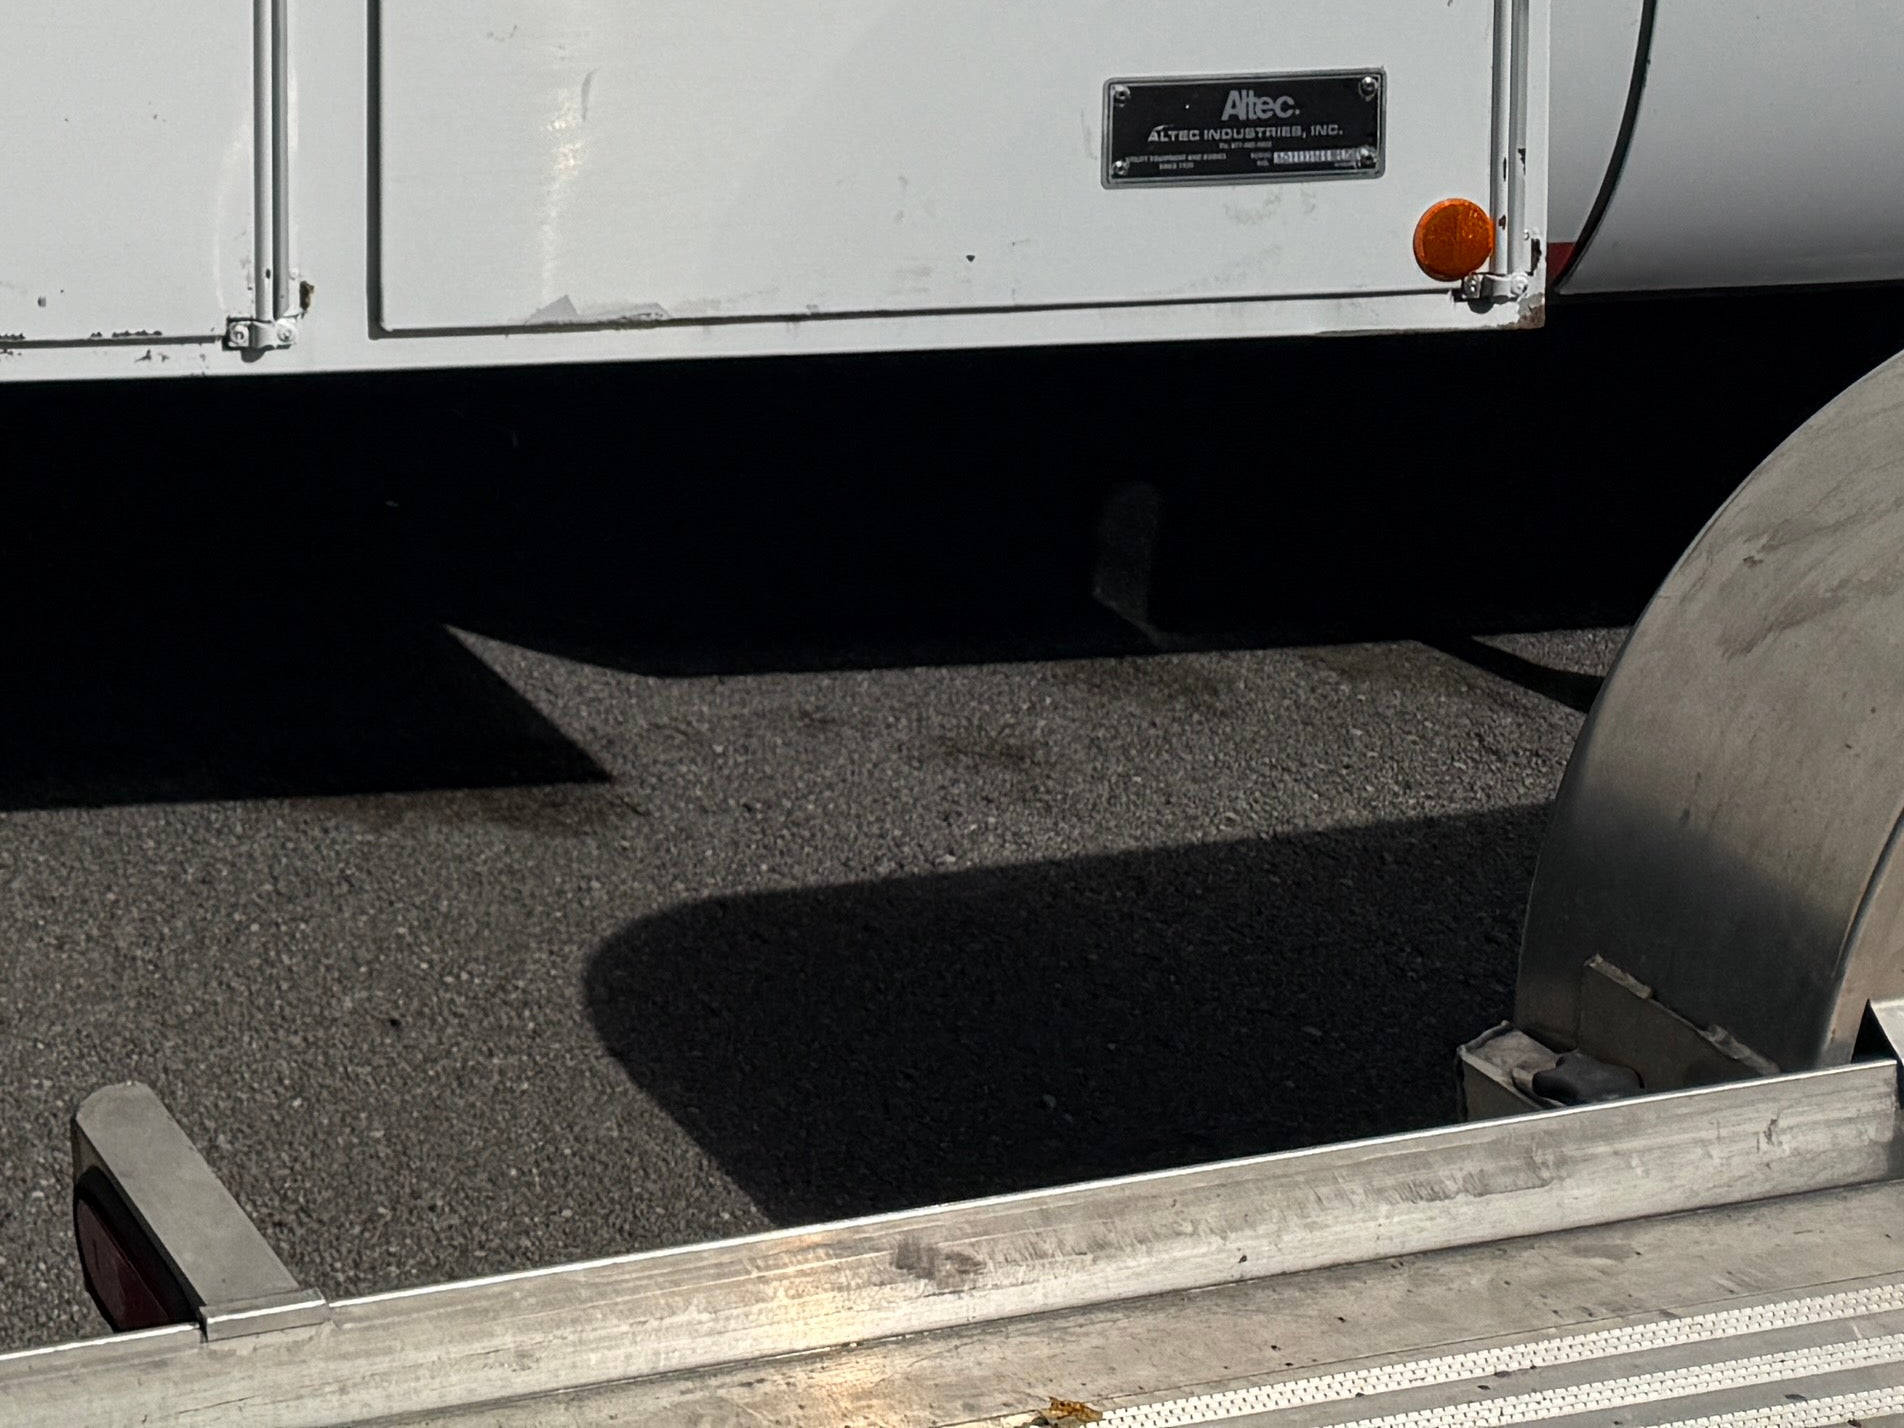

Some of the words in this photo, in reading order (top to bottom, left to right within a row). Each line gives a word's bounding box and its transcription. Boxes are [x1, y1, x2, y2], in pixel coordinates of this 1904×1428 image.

[1221, 89, 1299, 121] Altec
[1147, 124, 1200, 142] ALTEC
[1203, 125, 1307, 142] INDUSTRIES,
[1311, 124, 1344, 137] INC.
